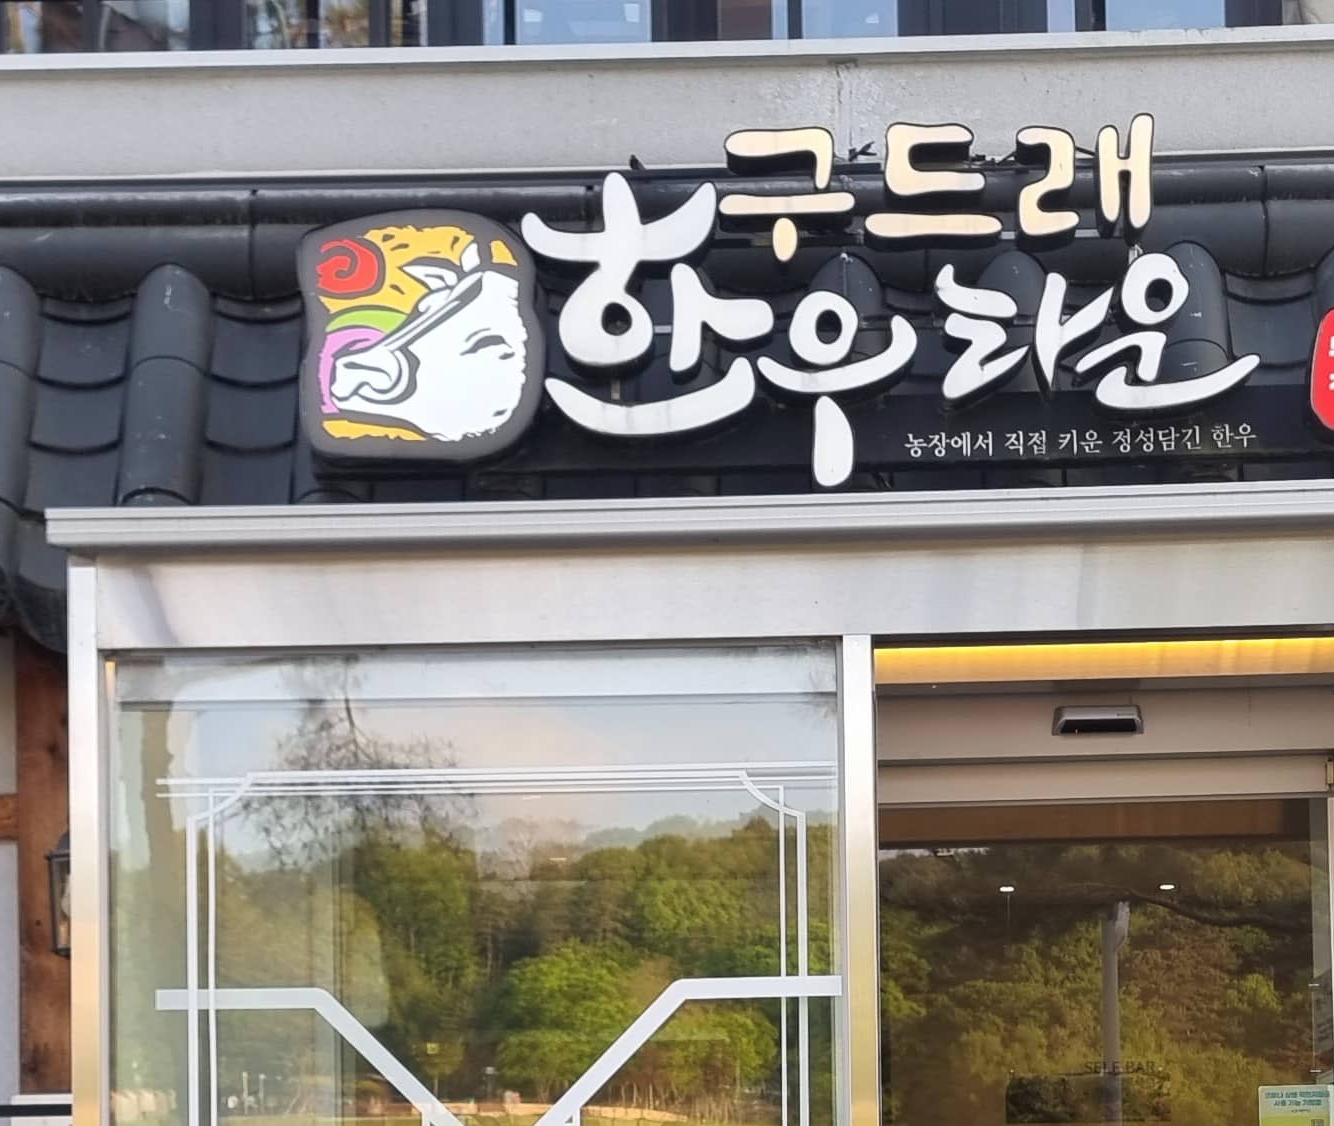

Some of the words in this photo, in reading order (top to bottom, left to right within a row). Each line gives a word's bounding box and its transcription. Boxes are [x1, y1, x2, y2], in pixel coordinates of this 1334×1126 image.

[720, 116, 1152, 262] 구드래
[520, 173, 1260, 487] 한우타운
[904, 431, 994, 457] 농장에서
[1004, 430, 1048, 455] 직접
[1058, 429, 1103, 453] 키운
[1112, 426, 1201, 452] 정성담긴
[1211, 422, 1257, 449] 한우
